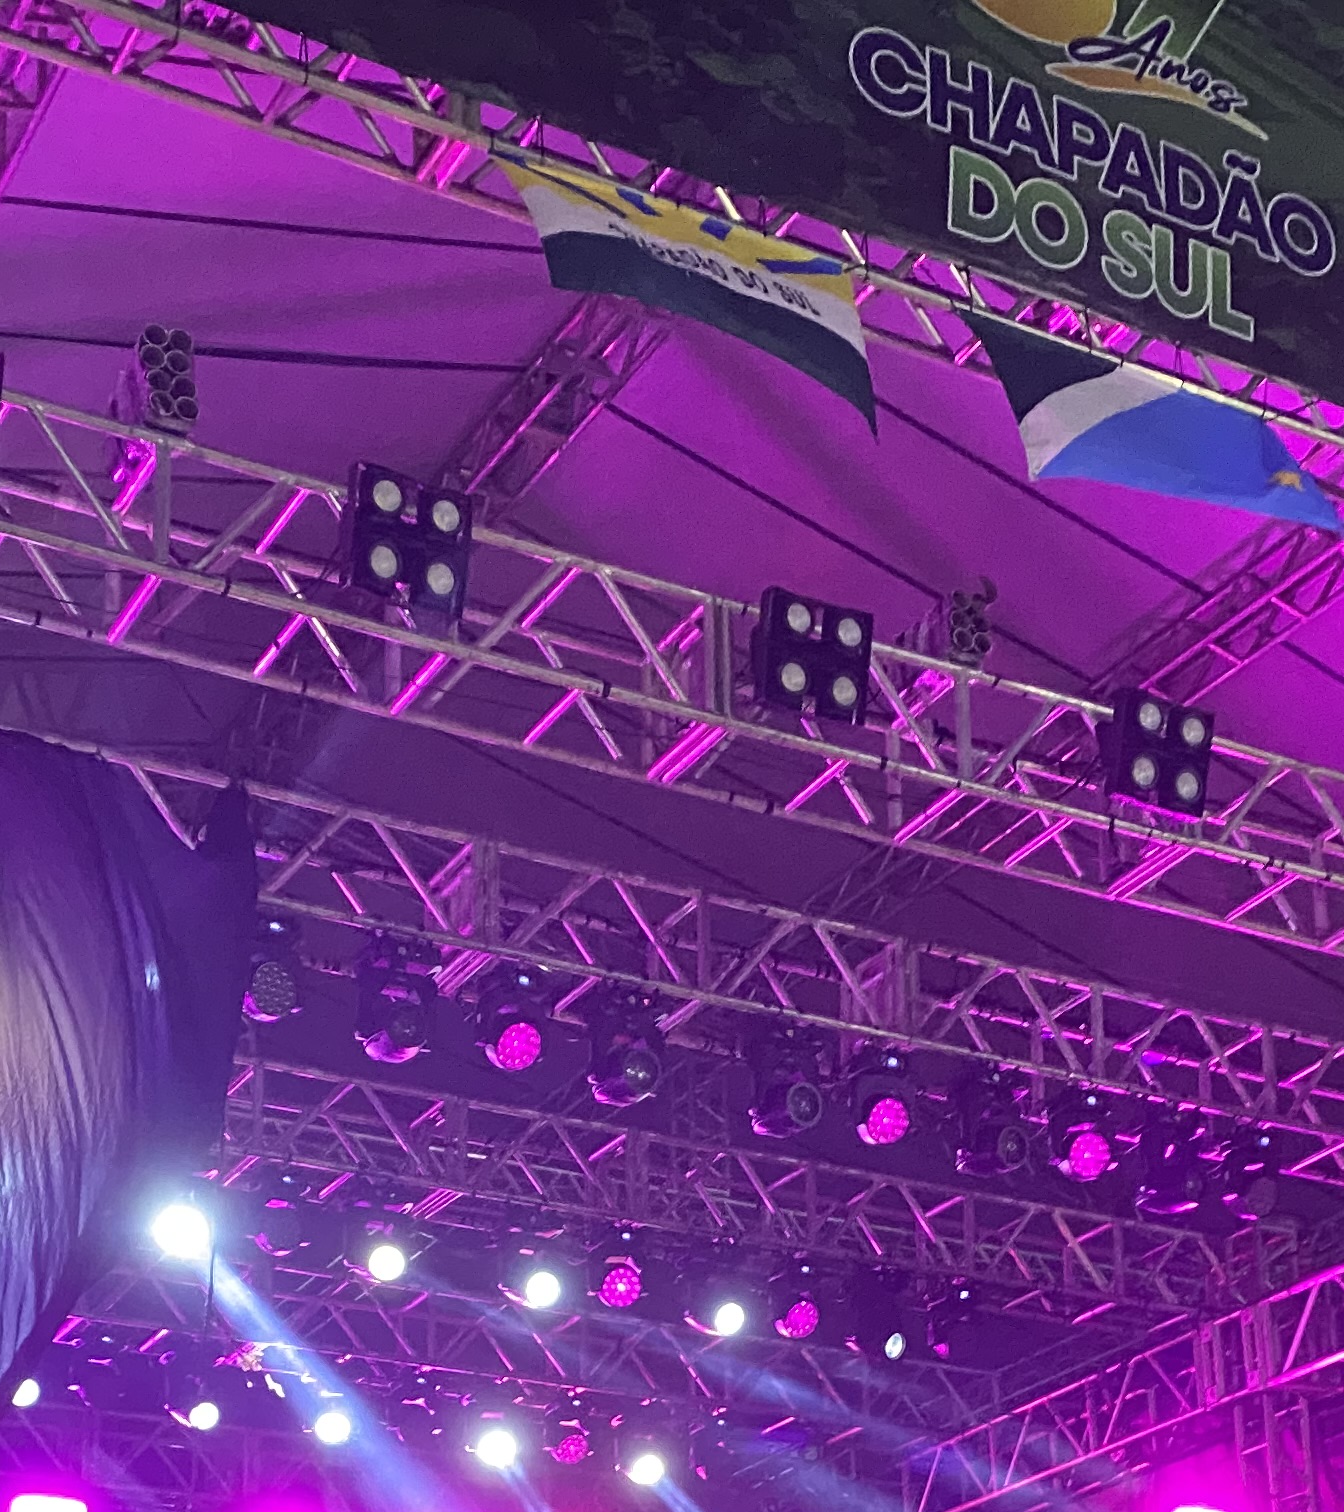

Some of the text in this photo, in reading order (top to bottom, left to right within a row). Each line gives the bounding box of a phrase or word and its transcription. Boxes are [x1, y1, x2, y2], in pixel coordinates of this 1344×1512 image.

[848, 26, 1336, 277] CHAPADÃO
[1065, 15, 1248, 114] Anos
[947, 145, 1254, 341] DO SUL
